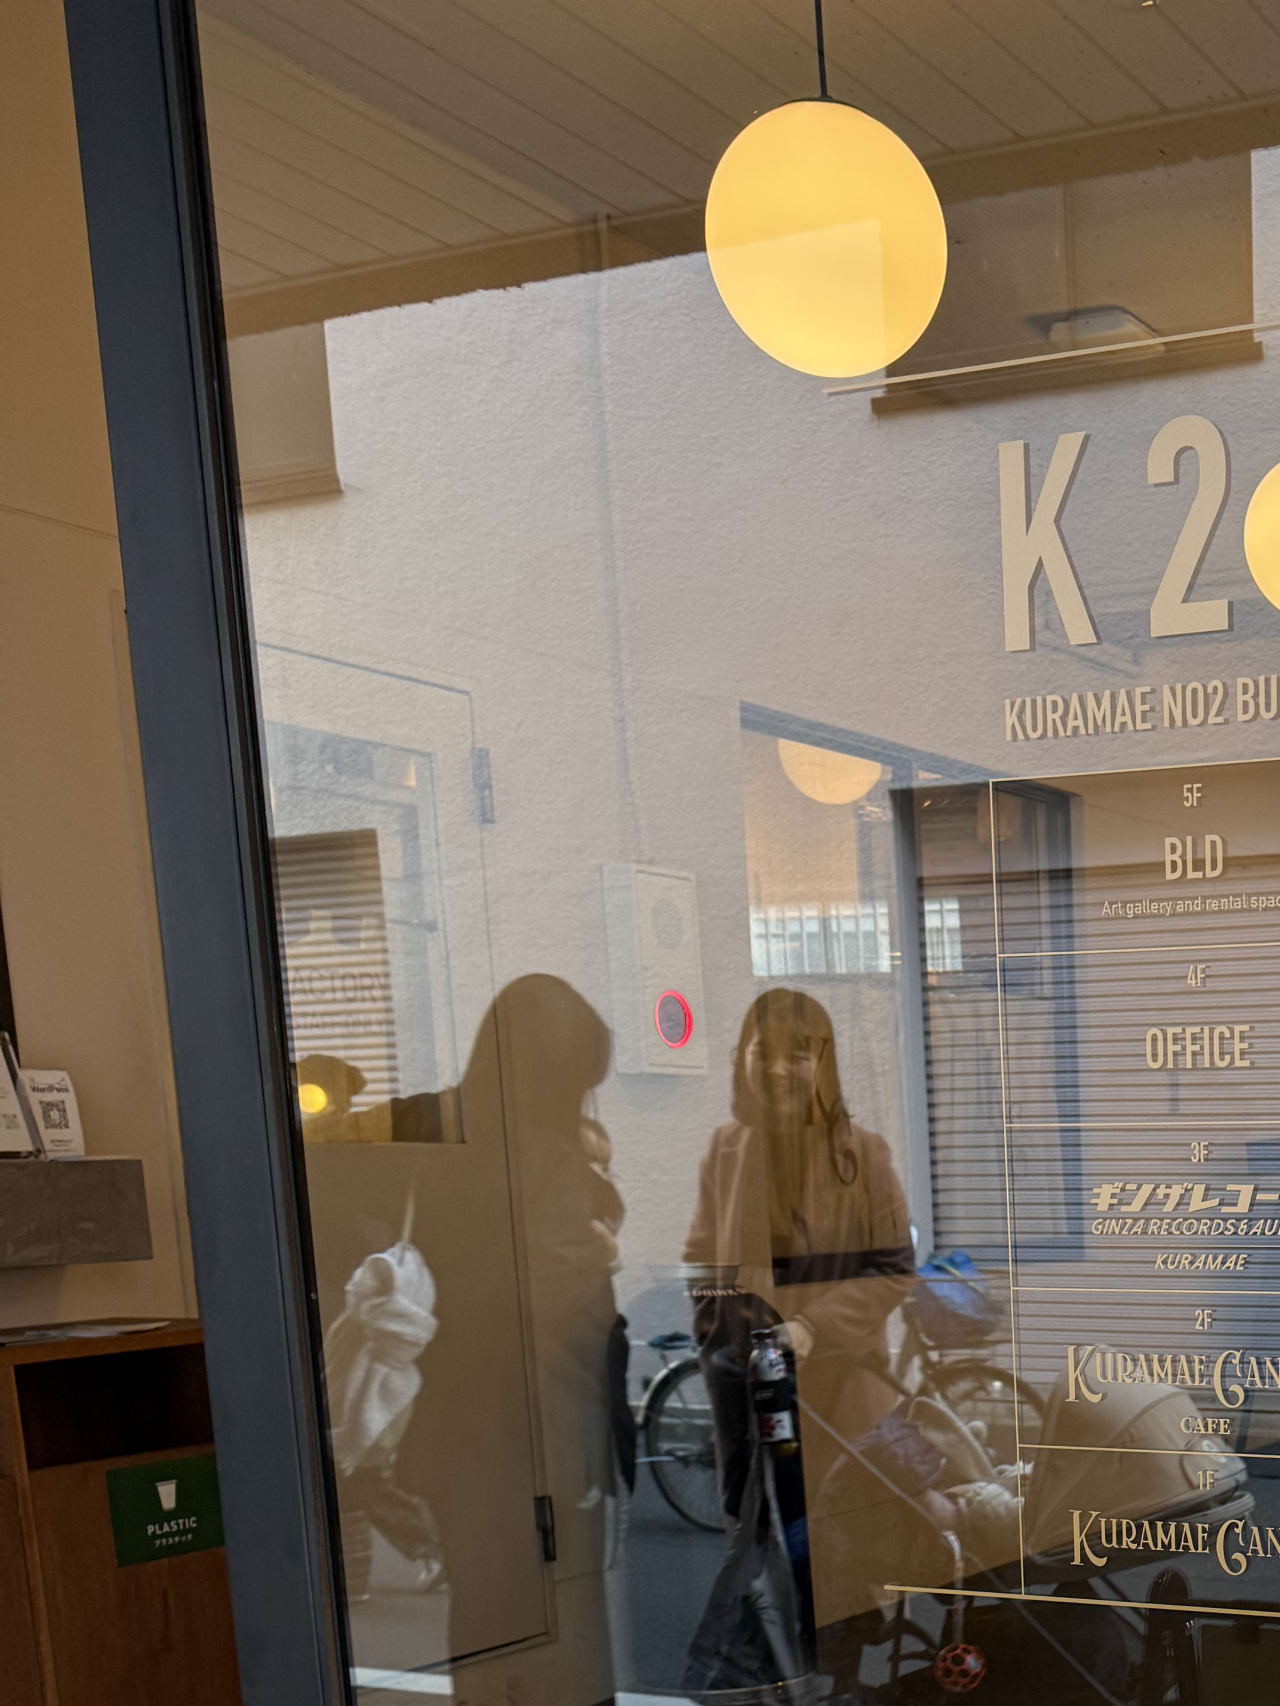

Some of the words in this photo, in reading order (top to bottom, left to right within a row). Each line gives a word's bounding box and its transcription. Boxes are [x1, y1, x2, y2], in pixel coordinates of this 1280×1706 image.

[1004, 686, 1152, 741] KURAMAE
[1162, 679, 1225, 728] NO2
[1183, 783, 1203, 808] 5F
[1164, 834, 1224, 881] BLD
[1102, 900, 1125, 917] Art
[1127, 897, 1174, 919] gallery
[1176, 896, 1202, 913] and
[1206, 894, 1247, 911] rental
[1187, 964, 1207, 989] 4F
[1144, 1024, 1252, 1068] OFFICE
[1190, 1142, 1209, 1164] 3F
[1091, 1218, 1142, 1236] GINZA
[1155, 1253, 1248, 1271] KURAMAE
[1194, 1310, 1213, 1330] 2F
[1065, 1345, 1207, 1404] KURAMAE
[1180, 1417, 1231, 1435] CAFE
[1197, 1471, 1215, 1491] 1F
[146, 1516, 198, 1537] PLASTIC
[153, 1533, 193, 1548] プラスチック
[1069, 1510, 1210, 1567] KURAMAE
